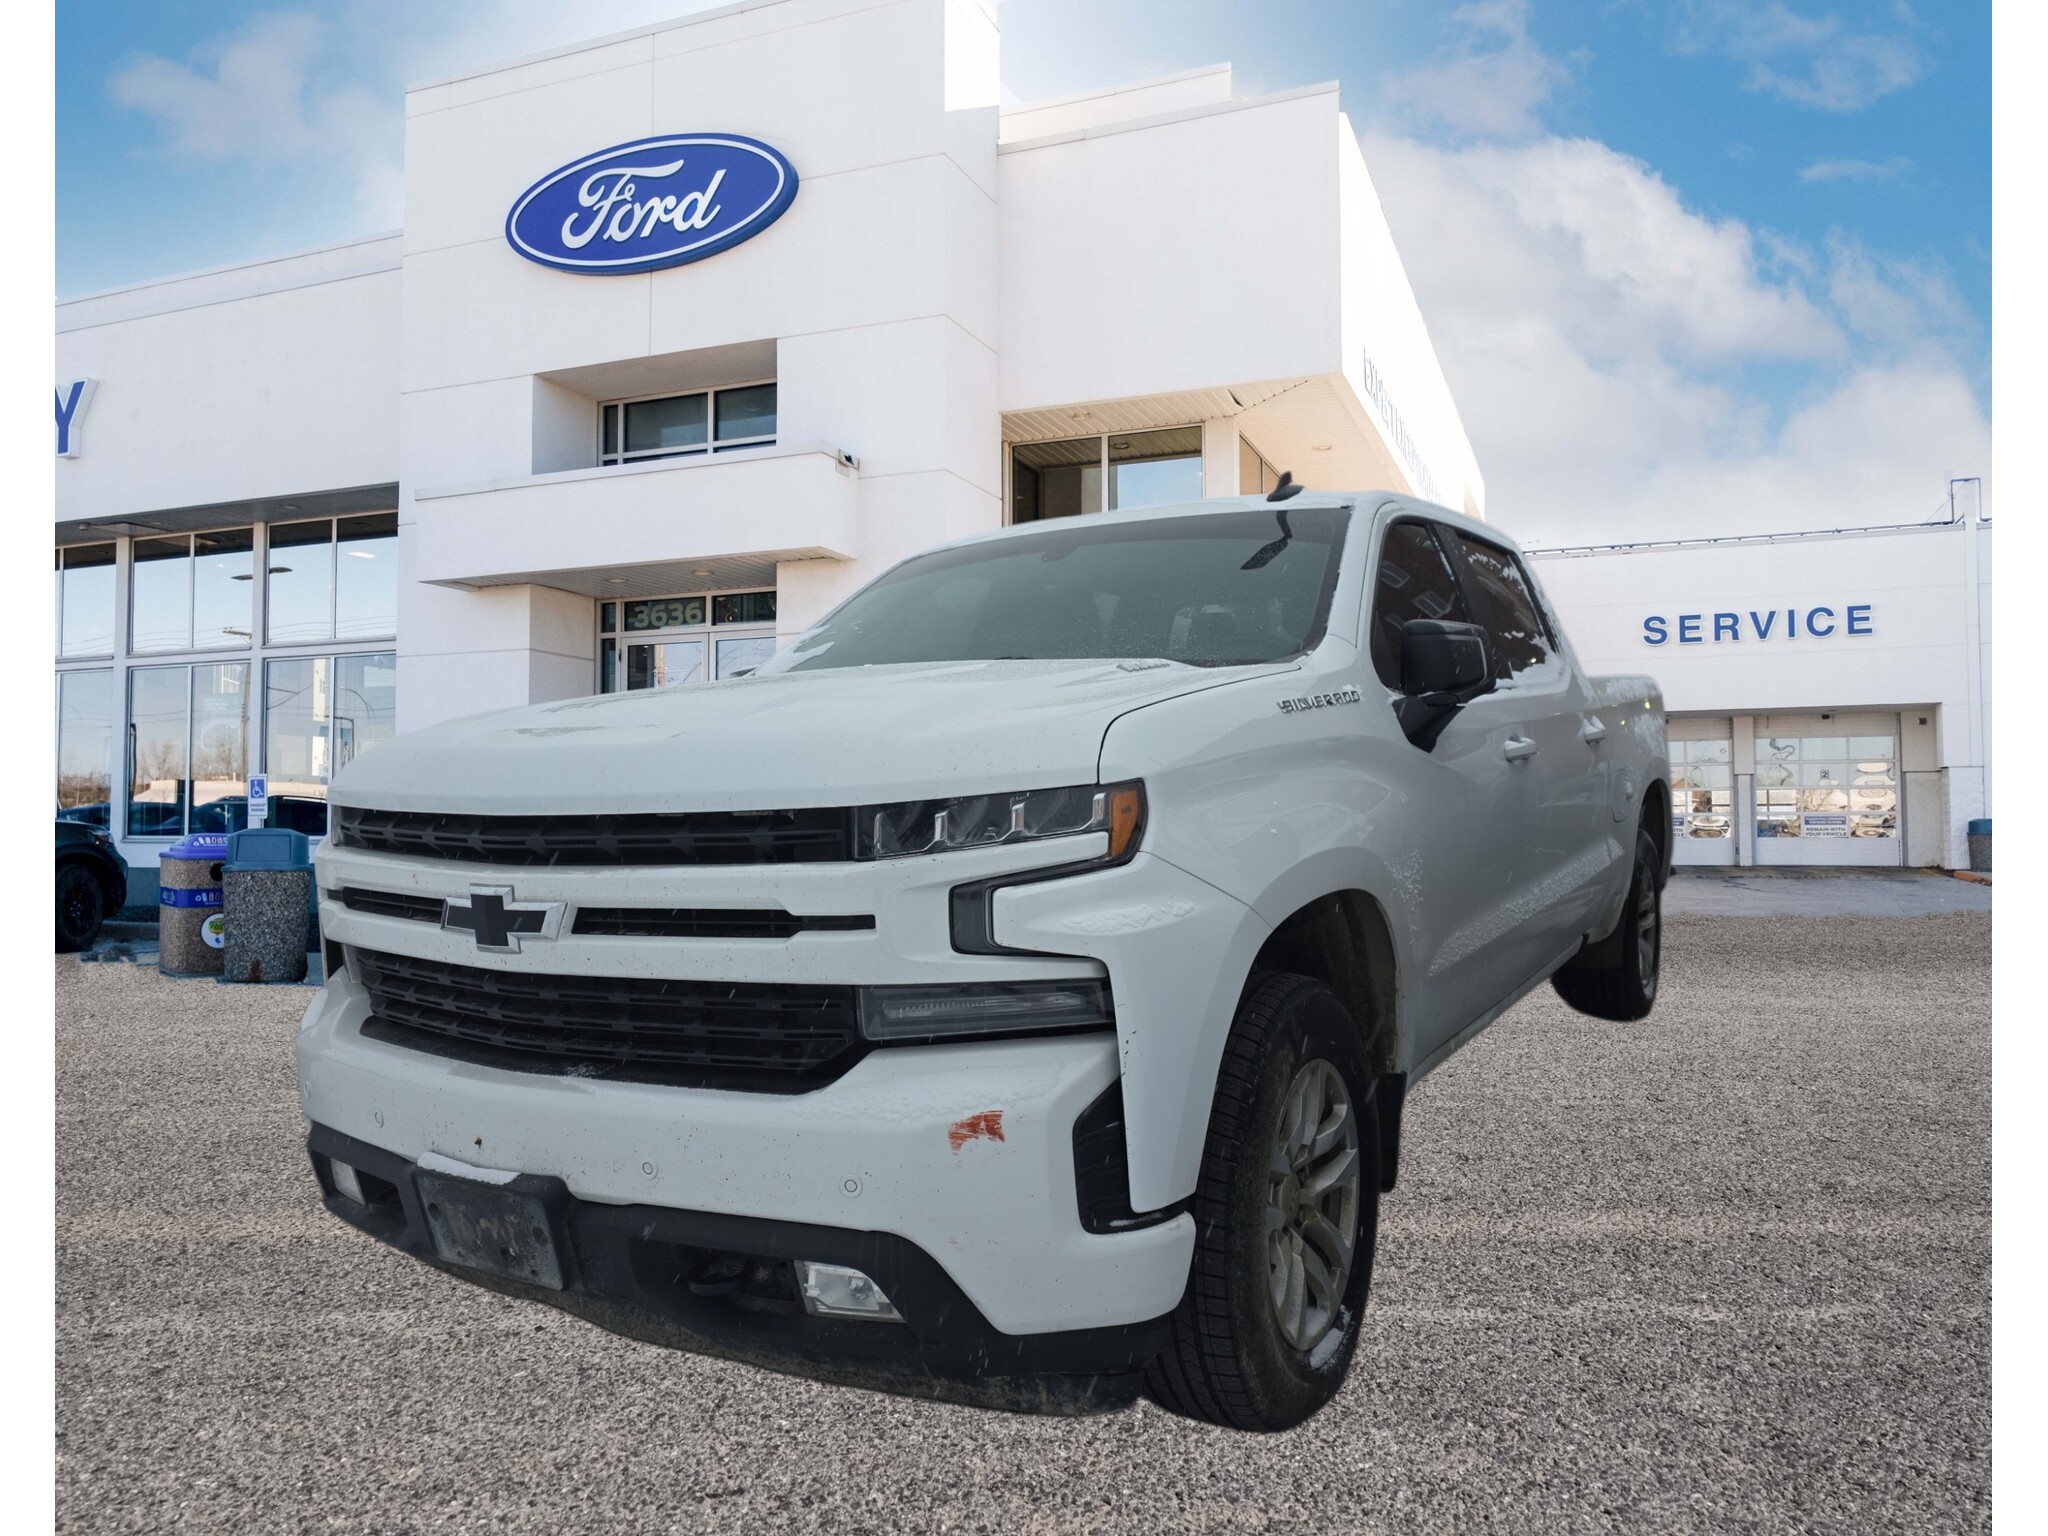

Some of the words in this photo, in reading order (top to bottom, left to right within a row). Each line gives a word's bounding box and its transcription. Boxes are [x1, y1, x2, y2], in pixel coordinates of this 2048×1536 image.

[561, 159, 727, 249] Ford
[633, 601, 702, 629] 3636
[1643, 603, 1874, 647] SERVICE
[1277, 690, 1361, 713] SILVERADO
